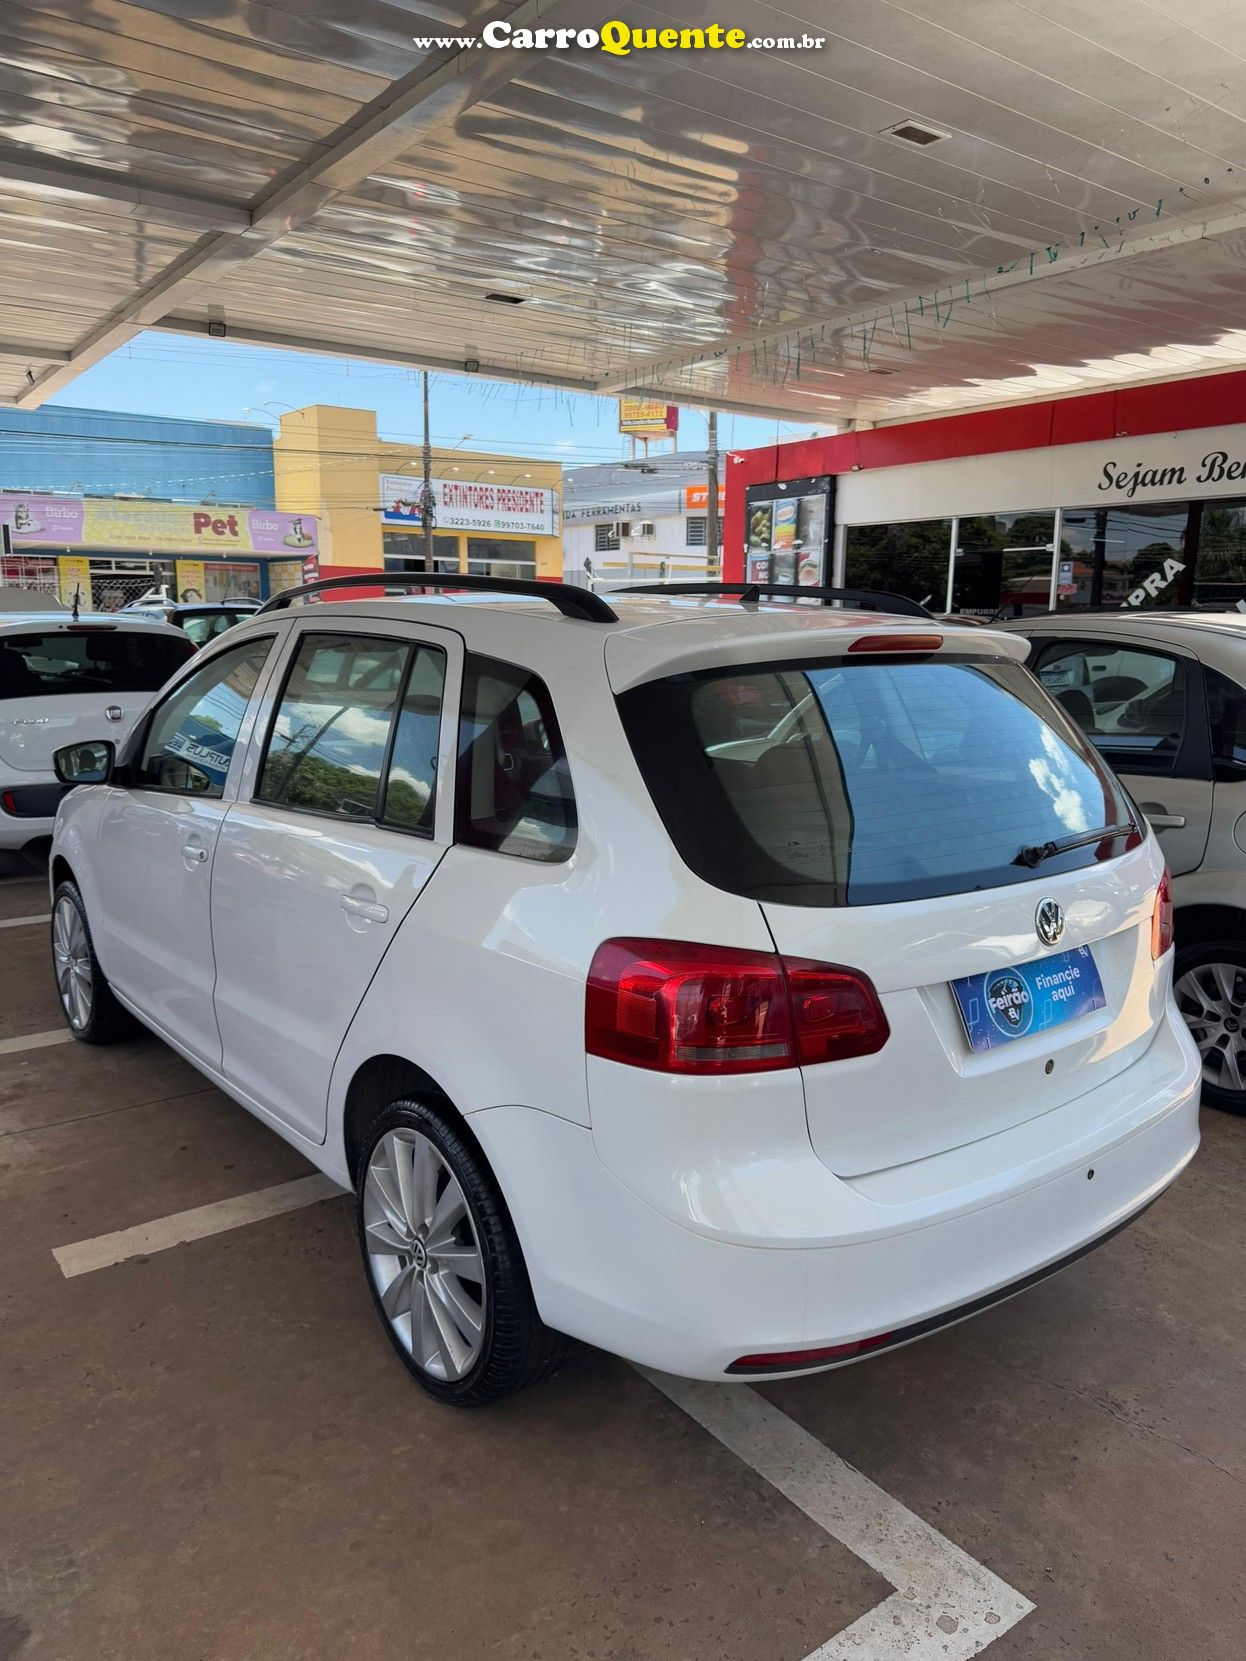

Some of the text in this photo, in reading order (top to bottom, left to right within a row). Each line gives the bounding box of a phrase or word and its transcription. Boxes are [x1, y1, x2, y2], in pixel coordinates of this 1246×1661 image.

[1098, 461, 1187, 498] Sejam
[443, 483, 545, 514] EXTINTORES PRESIDENTE
[581, 502, 642, 518] FERRAMENTAS
[45, 506, 79, 519] Birbo
[193, 512, 239, 537] Pet
[251, 519, 279, 531] Birbo
[450, 517, 492, 528] 3223-5926
[1120, 558, 1187, 608] PRA
[1035, 965, 1081, 990] Financie
[988, 987, 1030, 1014] Feirão
[1051, 981, 1075, 1002] aqui
